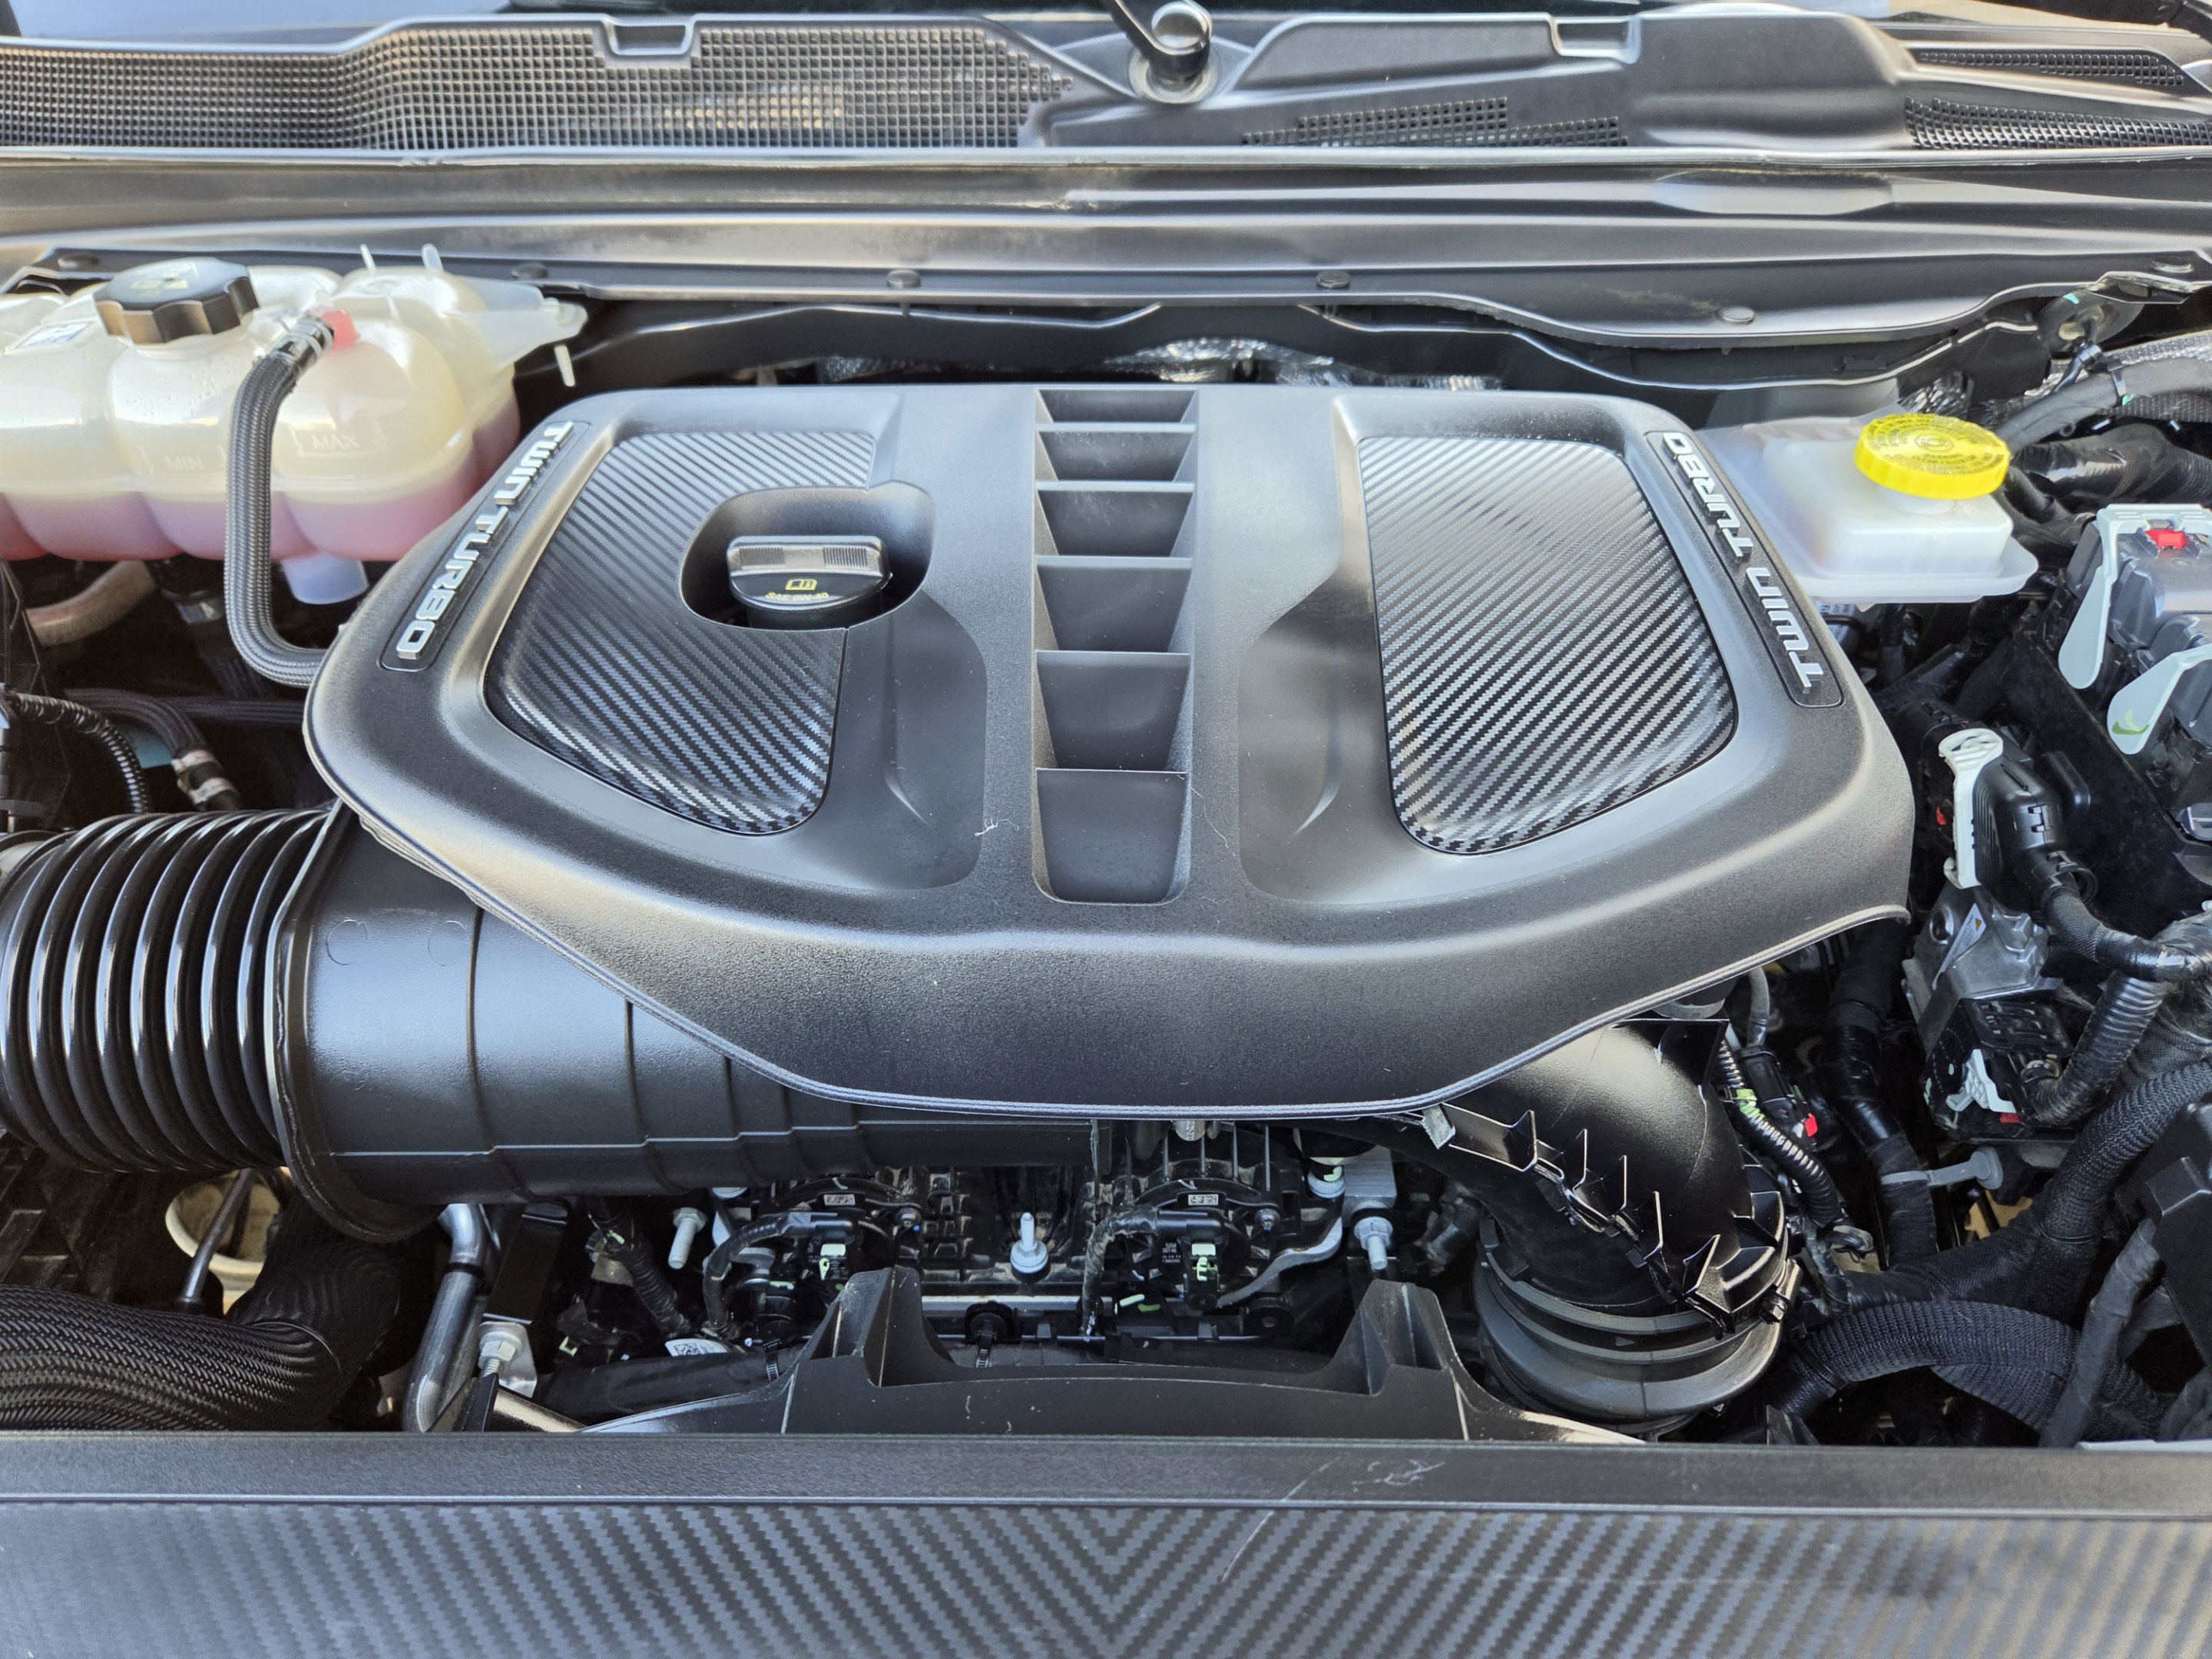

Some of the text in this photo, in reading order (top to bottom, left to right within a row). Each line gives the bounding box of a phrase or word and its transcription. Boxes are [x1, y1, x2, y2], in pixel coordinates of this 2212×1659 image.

[310, 433, 361, 449] MAX
[164, 455, 204, 471] MIN
[396, 420, 575, 658] TWIN TURBO
[1662, 431, 1823, 693] TWIN TURBO
[765, 591, 792, 600] SAE
